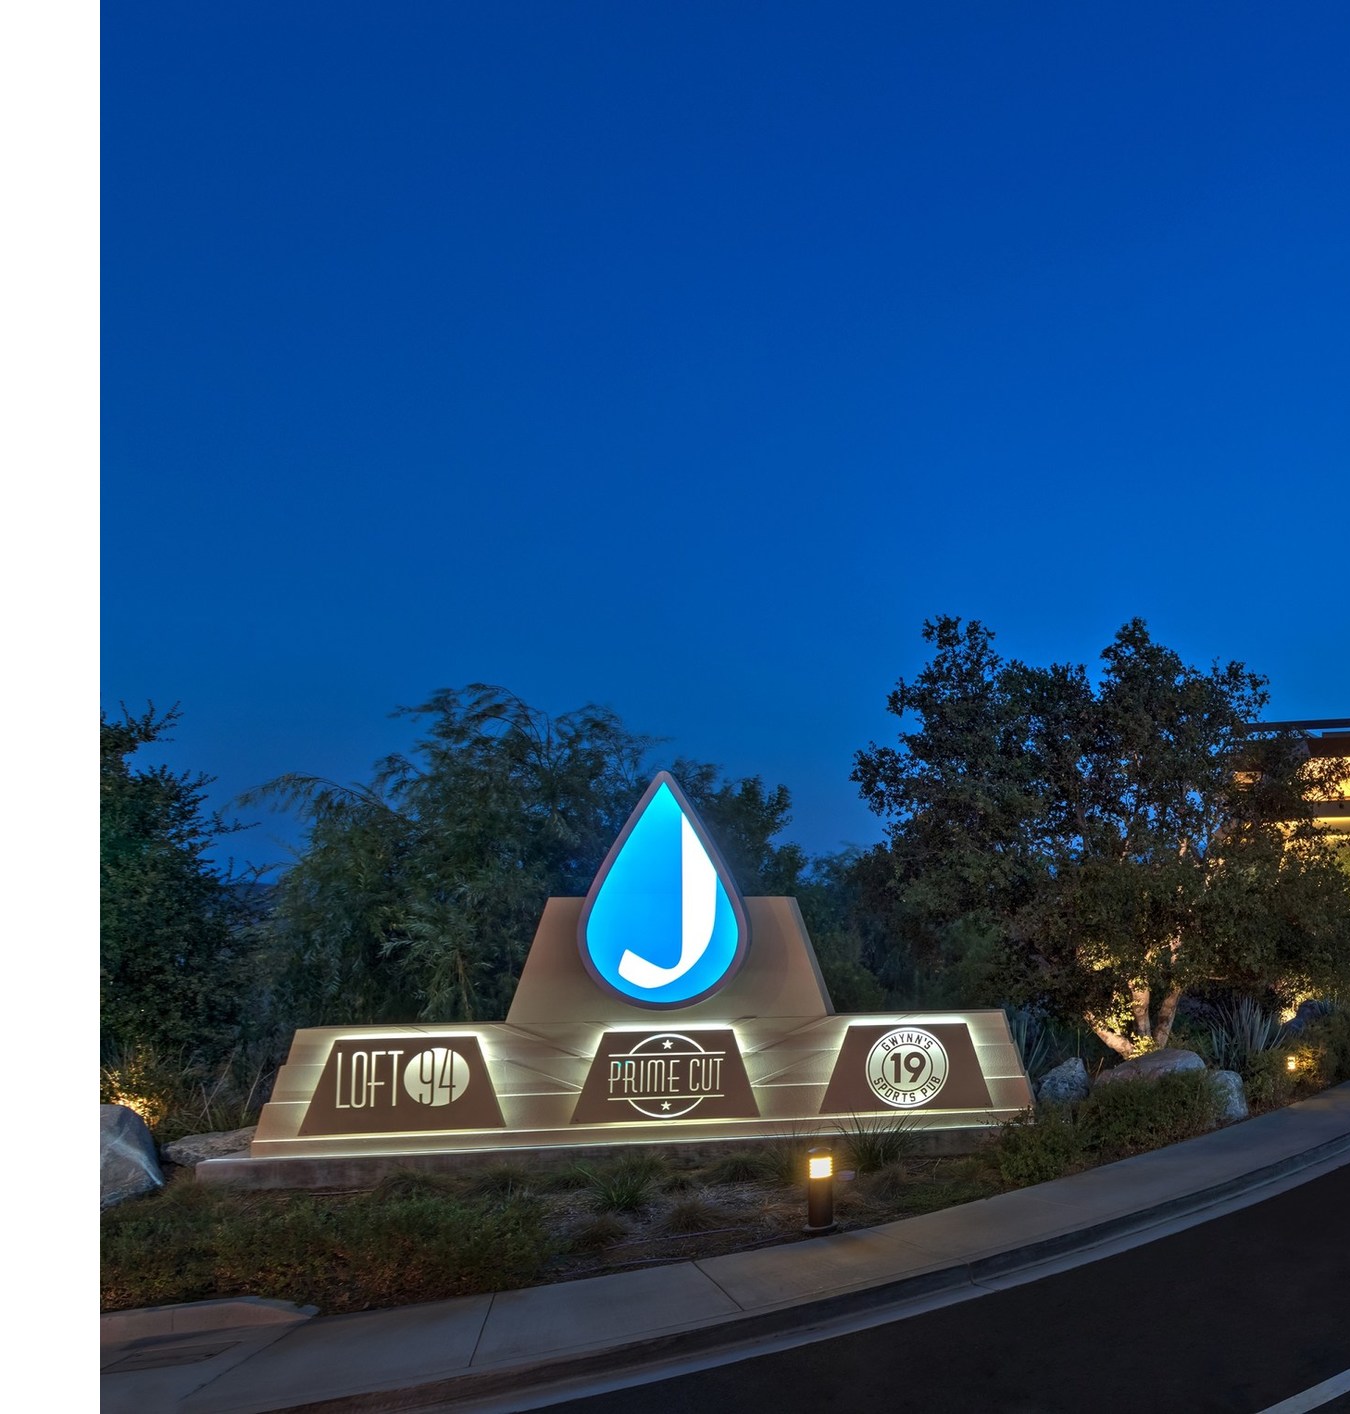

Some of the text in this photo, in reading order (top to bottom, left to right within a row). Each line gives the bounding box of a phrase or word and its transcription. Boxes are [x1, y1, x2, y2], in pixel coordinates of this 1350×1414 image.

[618, 812, 717, 988] J
[881, 1033, 933, 1052] GWYNN'S
[335, 1047, 457, 1109] LOFT 94
[608, 1058, 724, 1093] PRIME CUT
[890, 1051, 927, 1084] 19
[873, 1075, 941, 1103] SPORTS PUB
